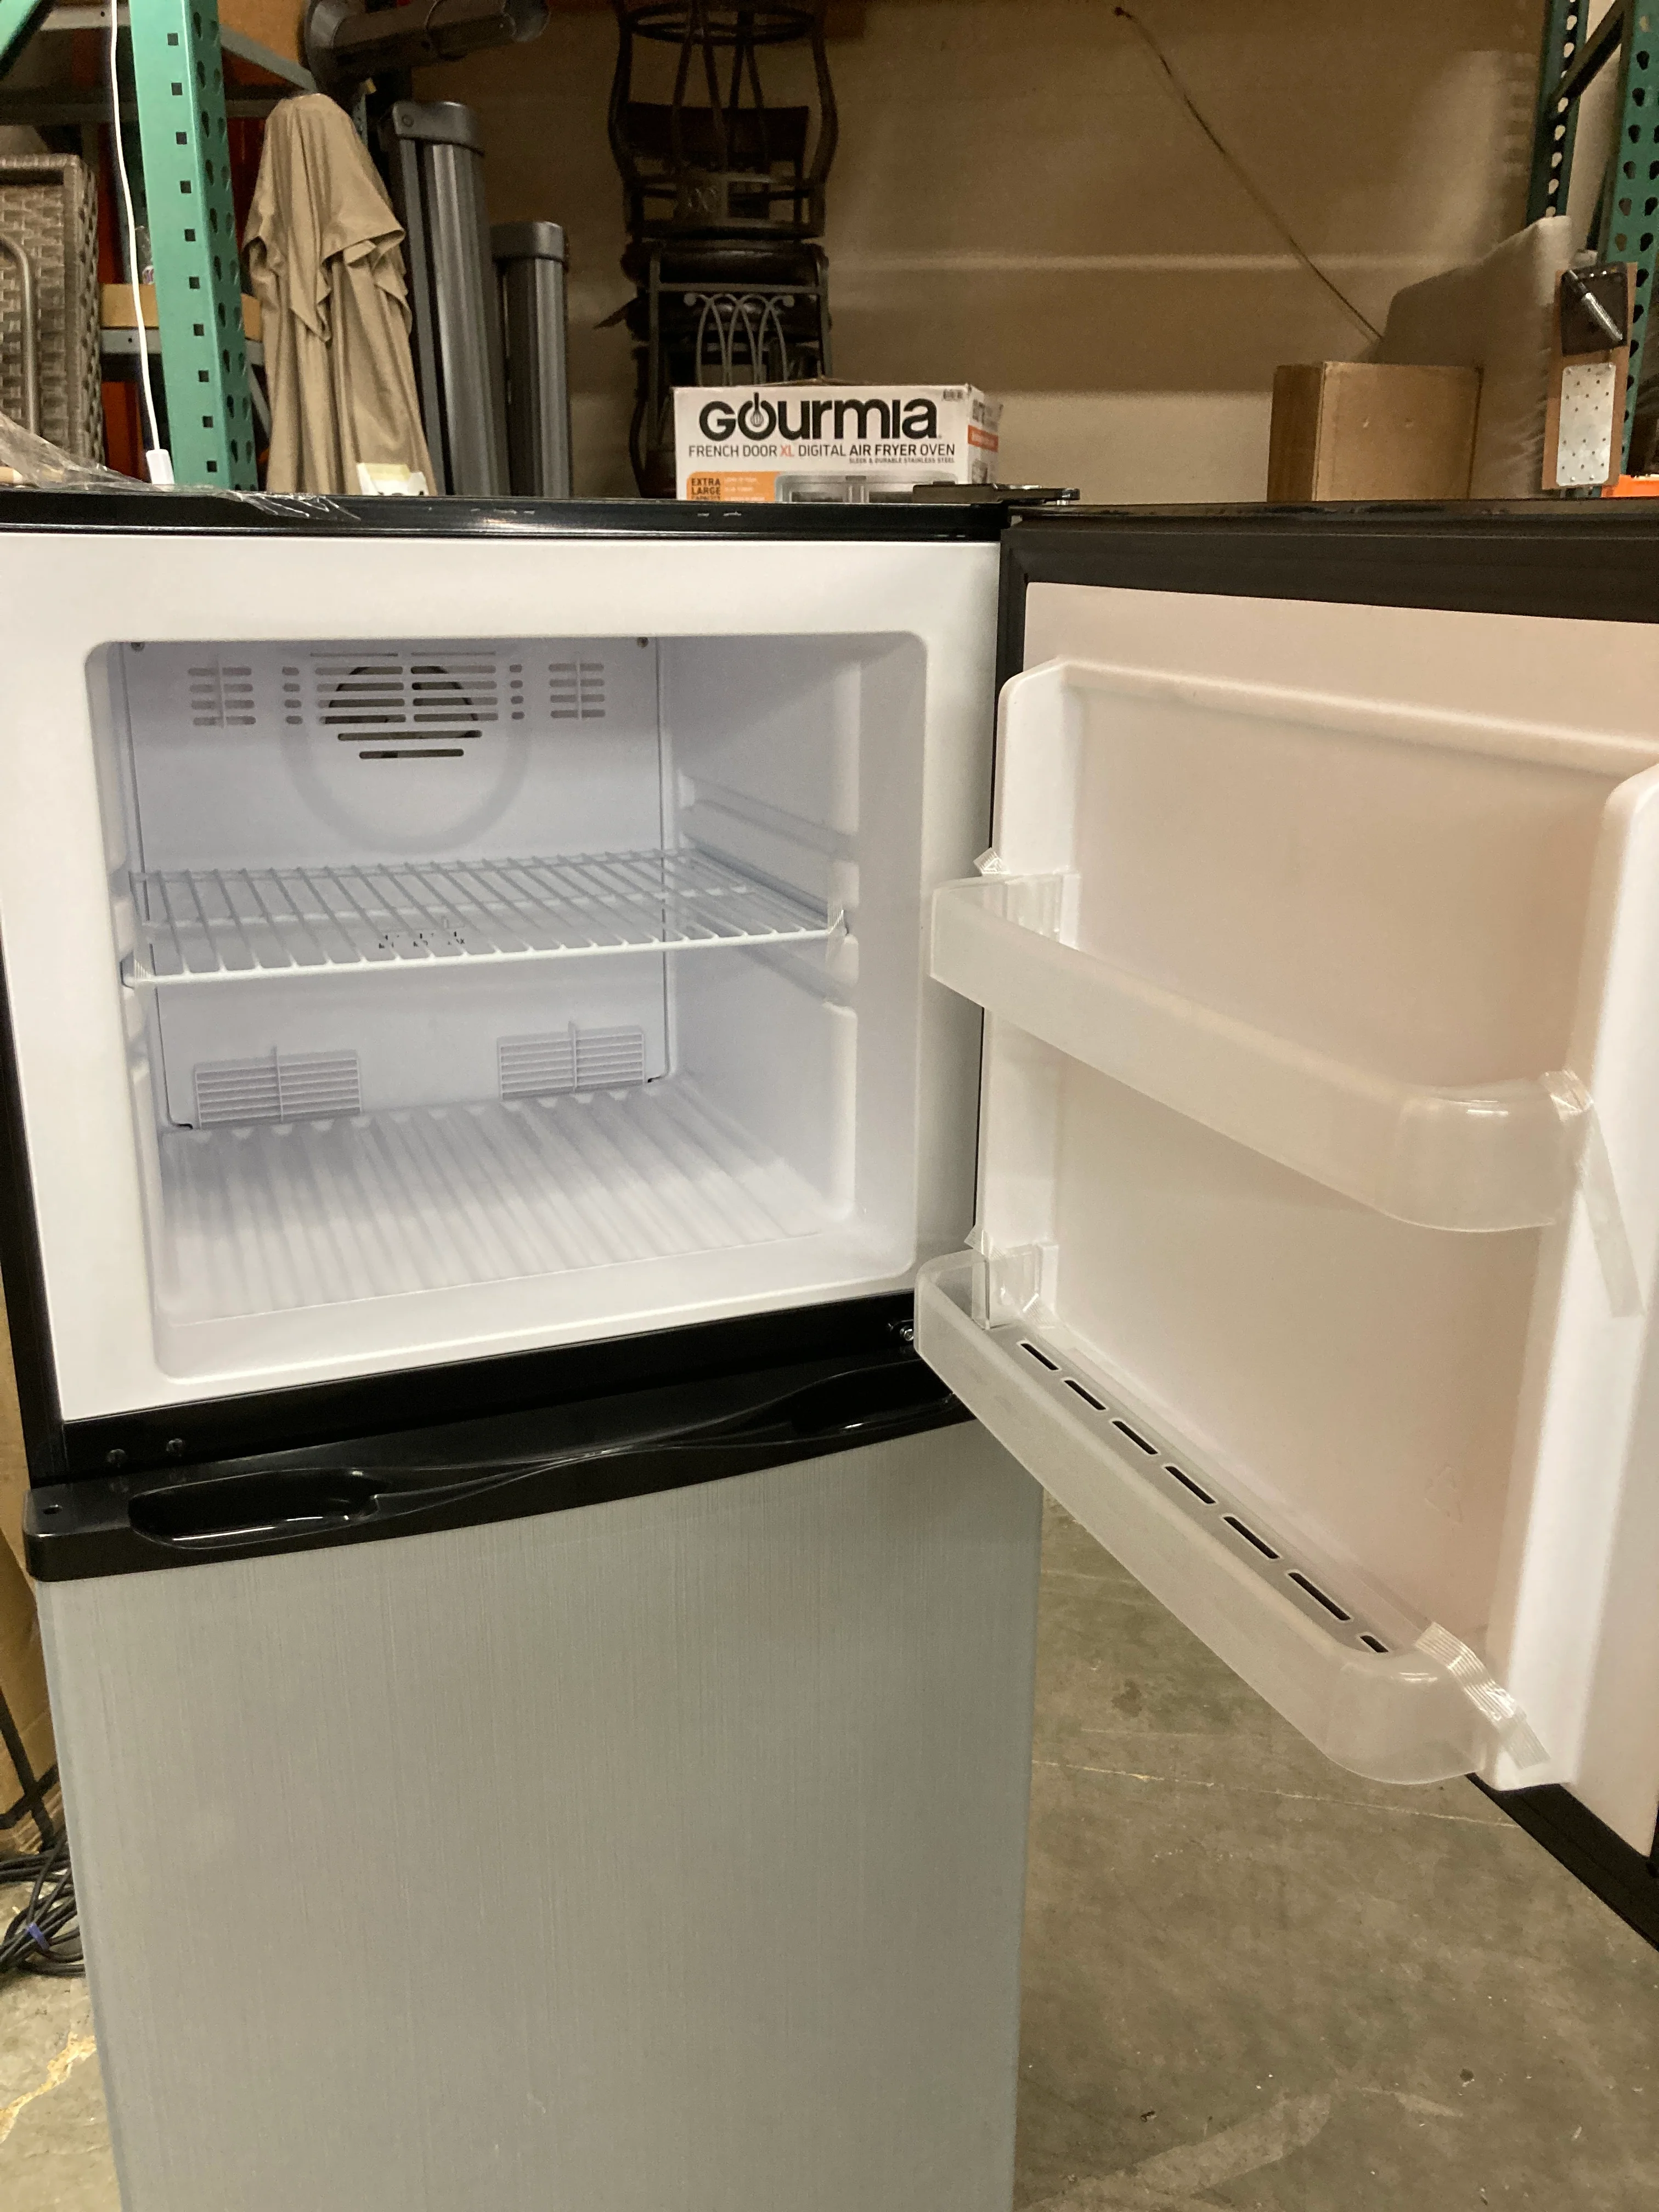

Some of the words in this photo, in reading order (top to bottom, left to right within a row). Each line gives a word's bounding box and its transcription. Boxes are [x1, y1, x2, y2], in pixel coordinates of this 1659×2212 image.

[699, 392, 938, 441] Gourmia
[689, 444, 739, 456] FRENCH
[743, 444, 777, 456] DOOR
[780, 444, 794, 456] XL
[798, 444, 846, 456] DIGITAL
[849, 443, 871, 456] AIR
[875, 443, 917, 456] FRYER
[920, 443, 955, 456] OVEN
[691, 478, 720, 486] EXTRA
[691, 487, 720, 495] LARGE
